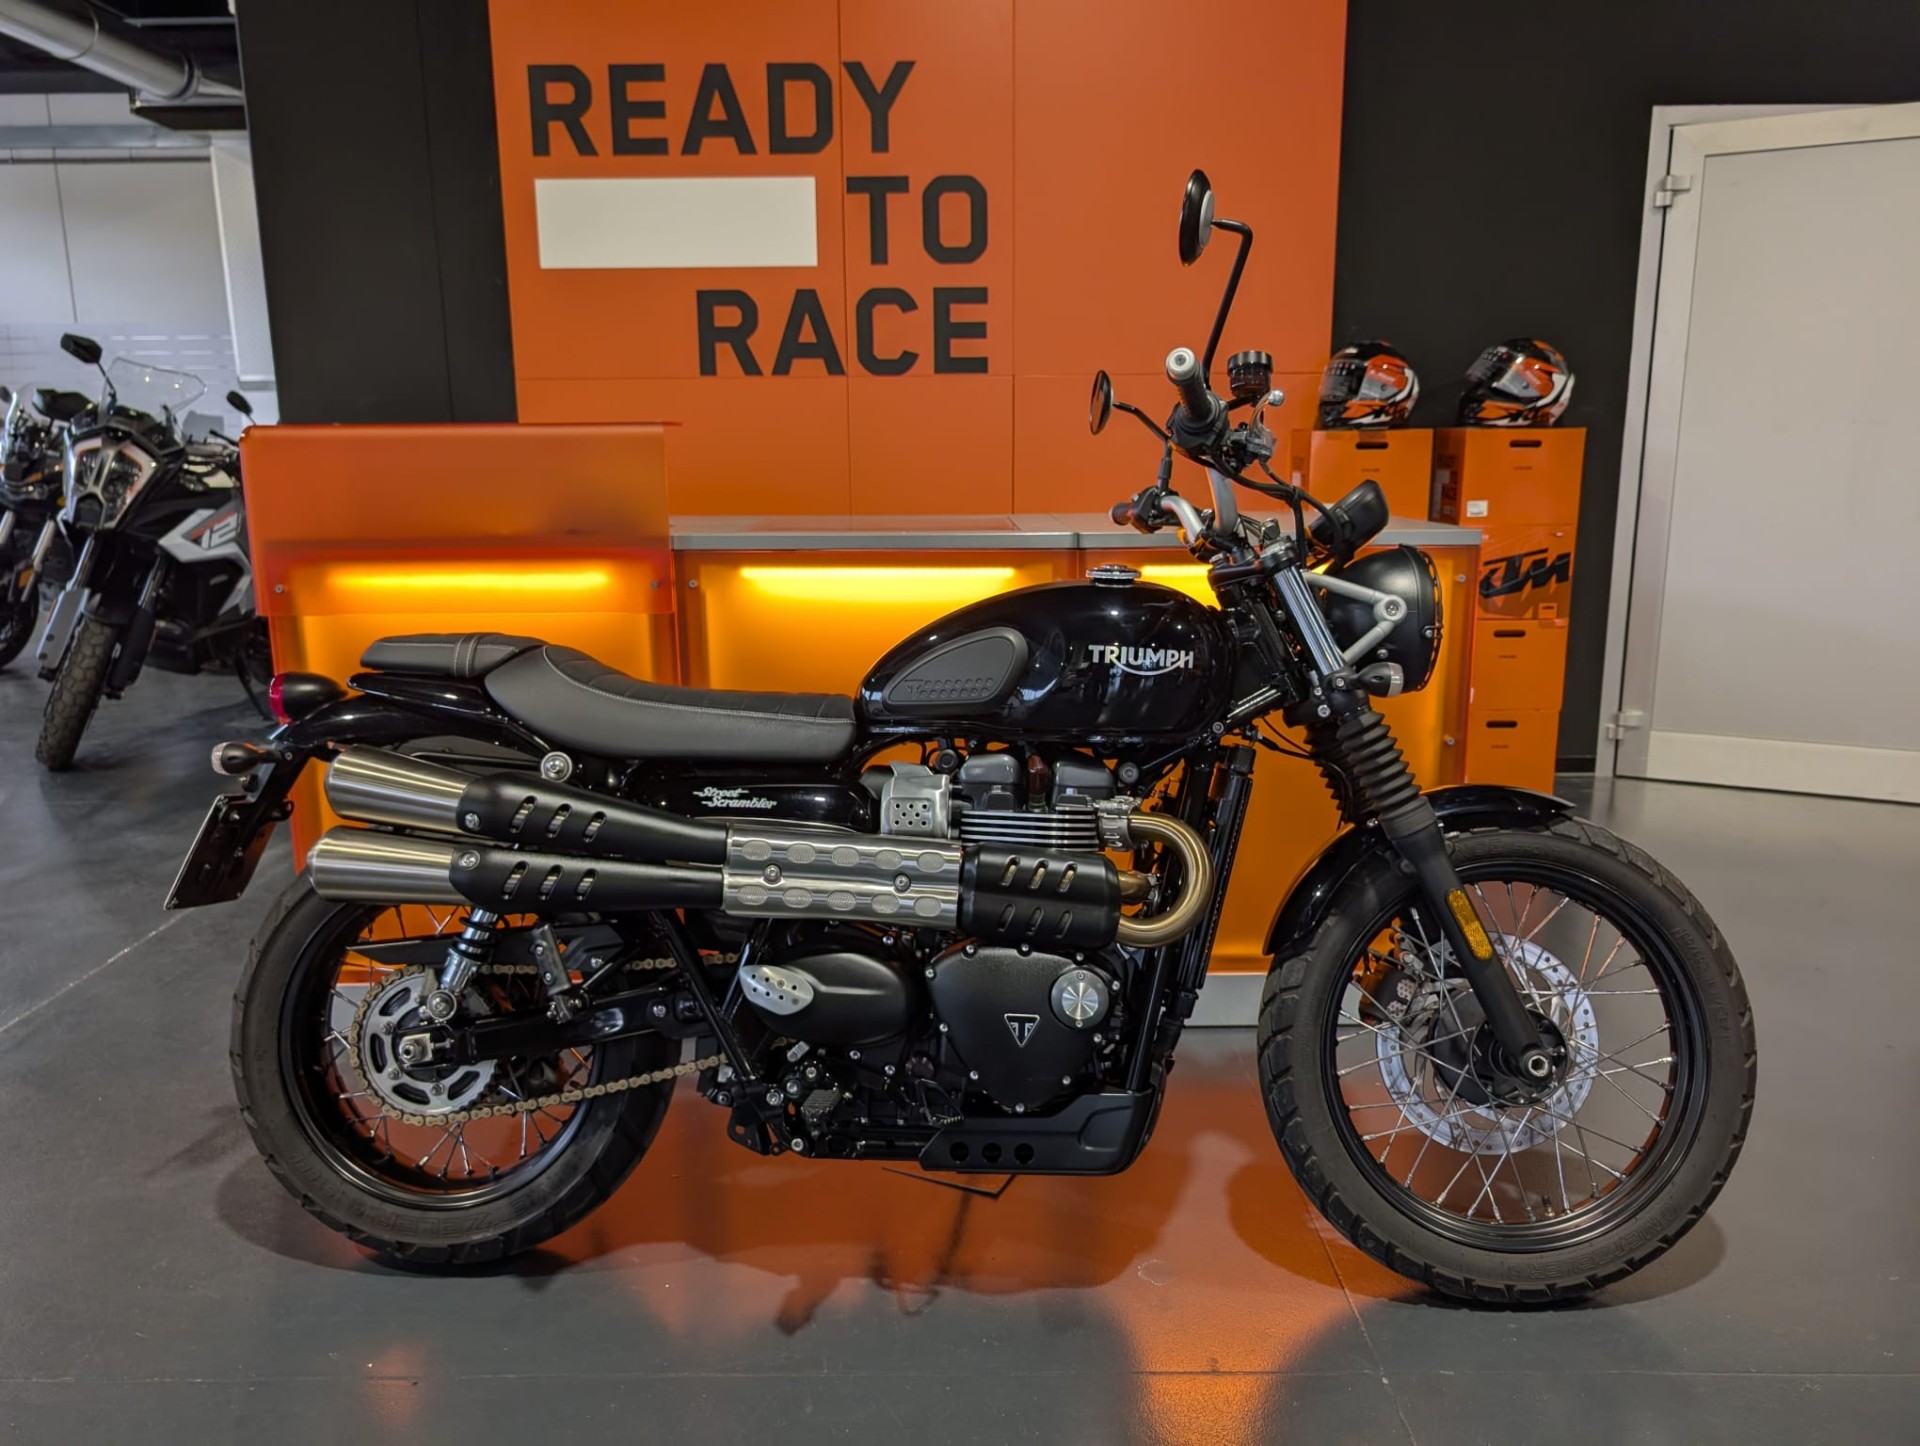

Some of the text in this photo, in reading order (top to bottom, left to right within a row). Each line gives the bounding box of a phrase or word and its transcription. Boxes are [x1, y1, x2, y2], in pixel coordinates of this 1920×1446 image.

[528, 61, 916, 156] READY
[846, 174, 988, 264] TO
[697, 286, 989, 376] RACE
[1088, 644, 1194, 675] TRIUMPH
[693, 786, 749, 799] Street
[702, 795, 777, 810] Scrambler
